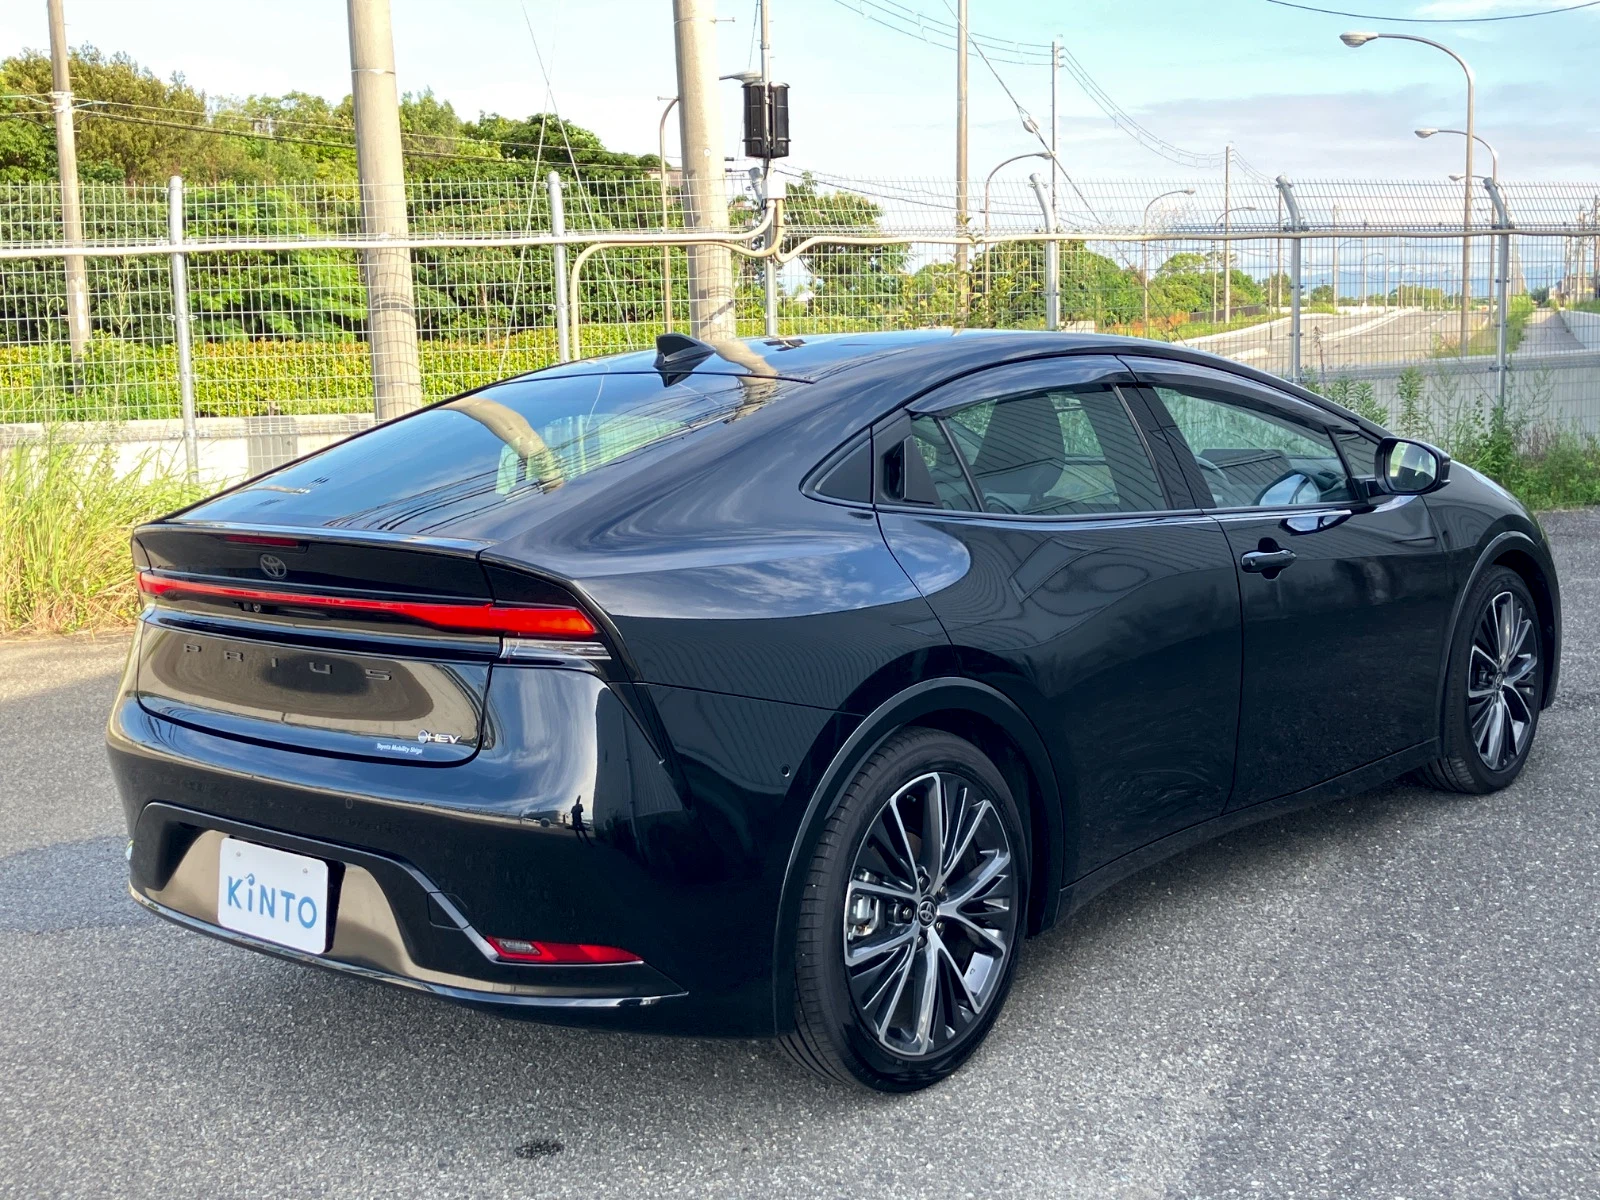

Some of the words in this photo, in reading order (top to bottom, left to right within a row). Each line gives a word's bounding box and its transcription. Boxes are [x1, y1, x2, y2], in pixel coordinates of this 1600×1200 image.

[184, 643, 392, 681] PRIUS
[427, 733, 461, 744] HEV
[392, 745, 410, 753] Mobility
